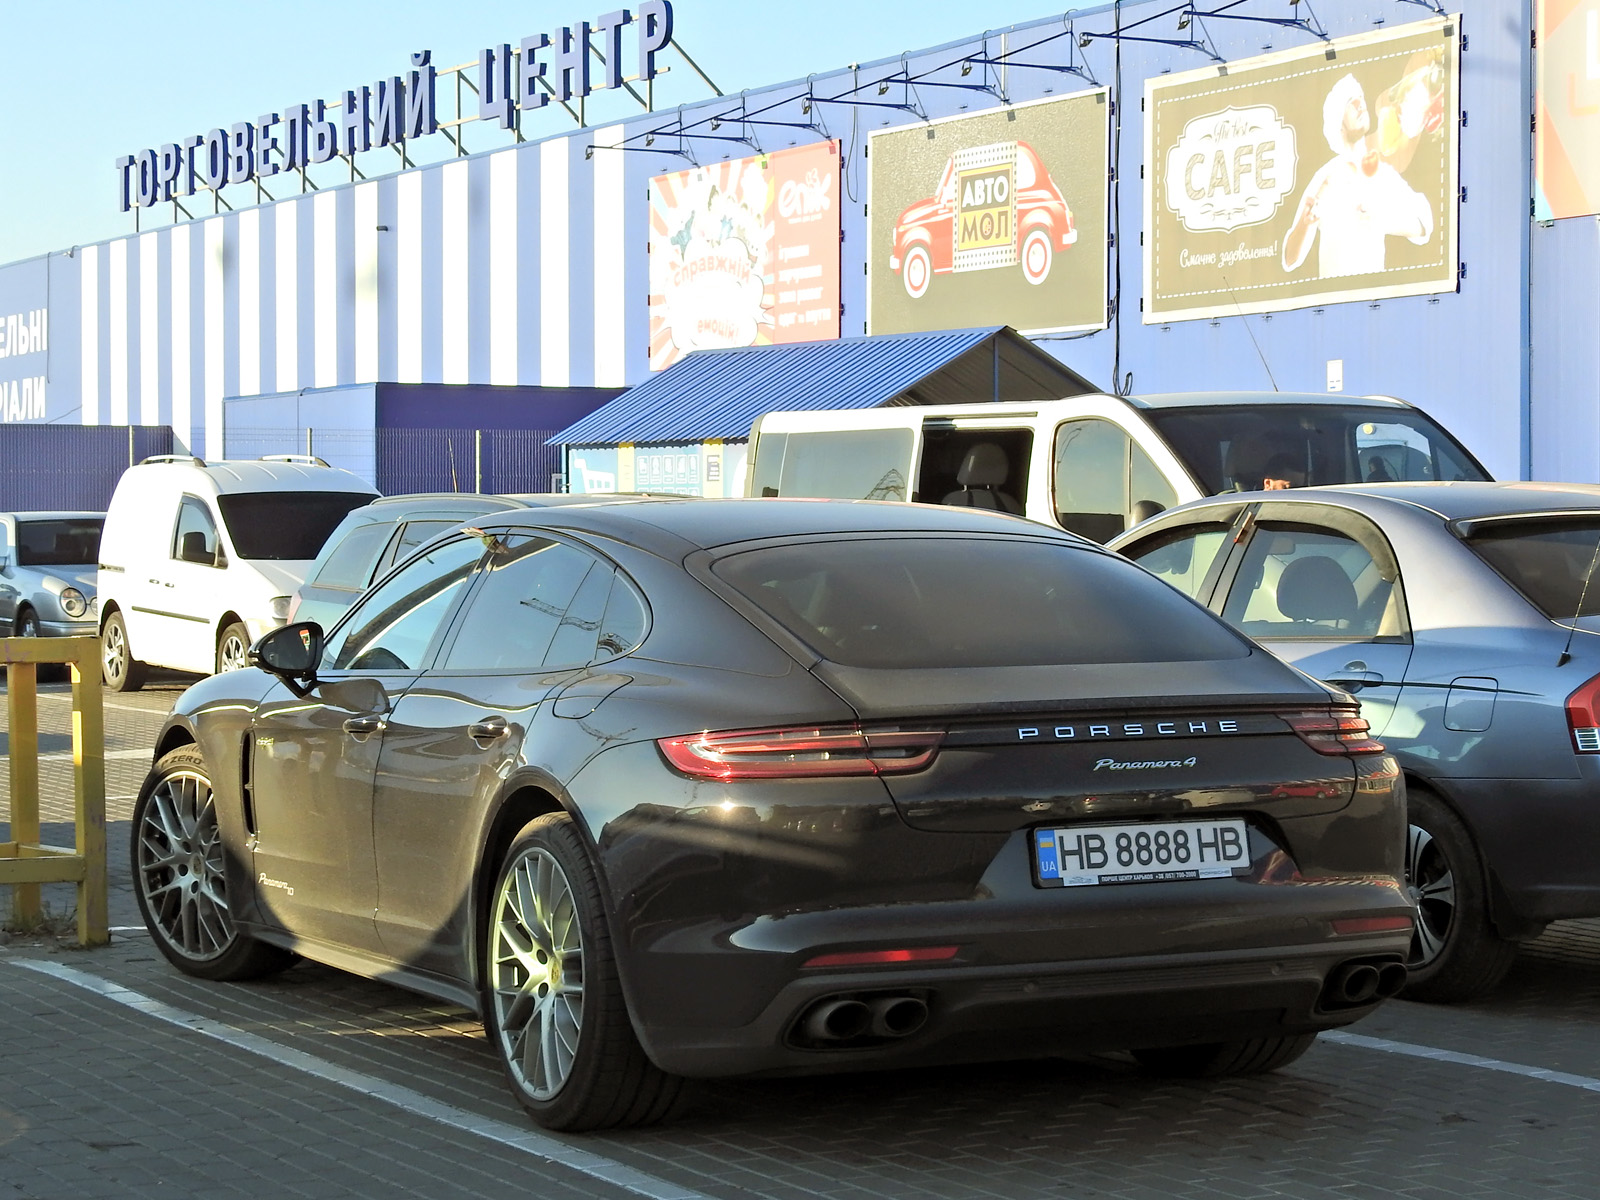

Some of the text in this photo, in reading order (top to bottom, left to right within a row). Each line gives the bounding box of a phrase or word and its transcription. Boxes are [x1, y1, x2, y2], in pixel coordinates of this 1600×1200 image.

[116, 0, 674, 212] ТОРГОВЕЛЬНИЙ ЦЕНТР
[1185, 140, 1276, 201] CAFE
[962, 175, 1009, 208] АВТО
[961, 210, 1009, 244] МОЛ
[1179, 239, 1278, 269] Смачне задоволення!
[673, 255, 752, 288] справжній
[1018, 720, 1238, 740] PORSCHE
[169, 754, 203, 766] ZERO
[1115, 829, 1191, 867] 8888
[1041, 861, 1057, 873] UA
